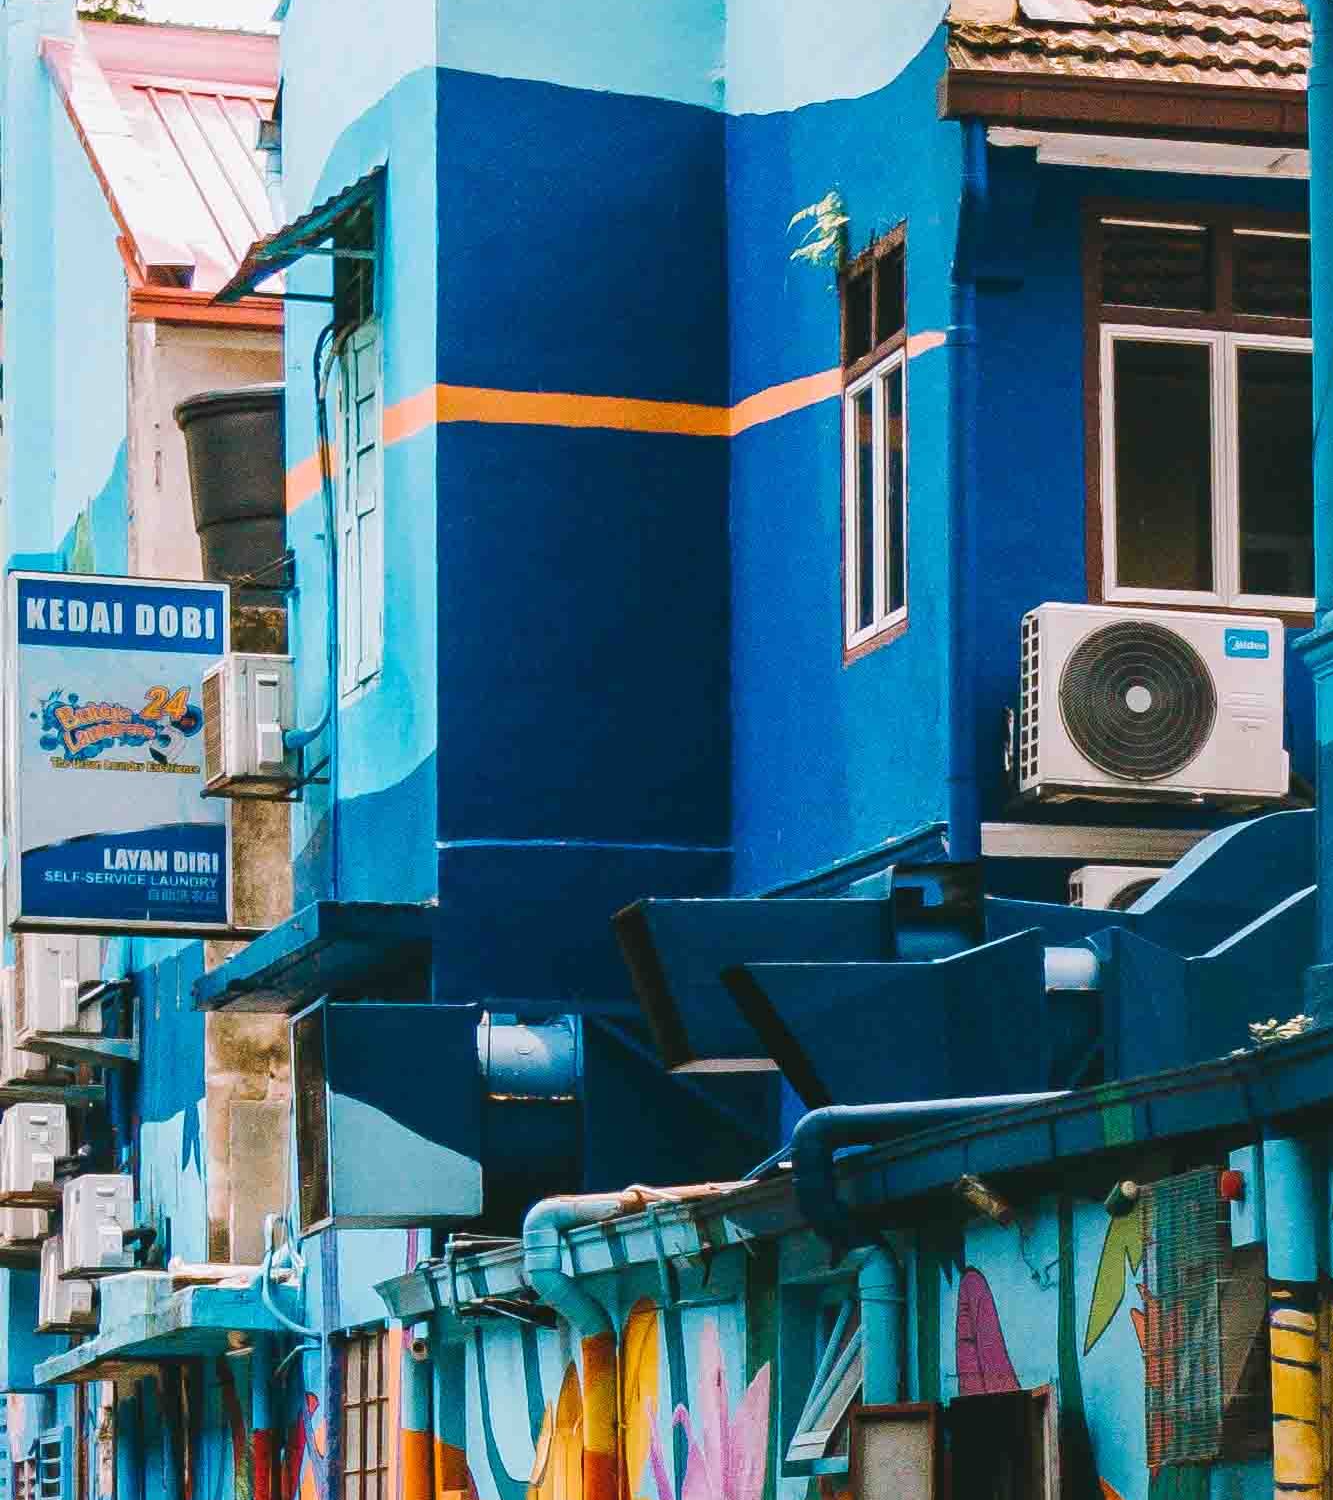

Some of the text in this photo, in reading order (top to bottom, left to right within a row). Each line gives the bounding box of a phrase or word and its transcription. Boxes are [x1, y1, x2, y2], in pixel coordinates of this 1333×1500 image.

[26, 597, 215, 640] KEDAI DOBI
[139, 684, 191, 722] 24
[103, 848, 219, 874] LAYAN DIRI
[44, 870, 217, 888] SELF-SERVICE LAUNDRY
